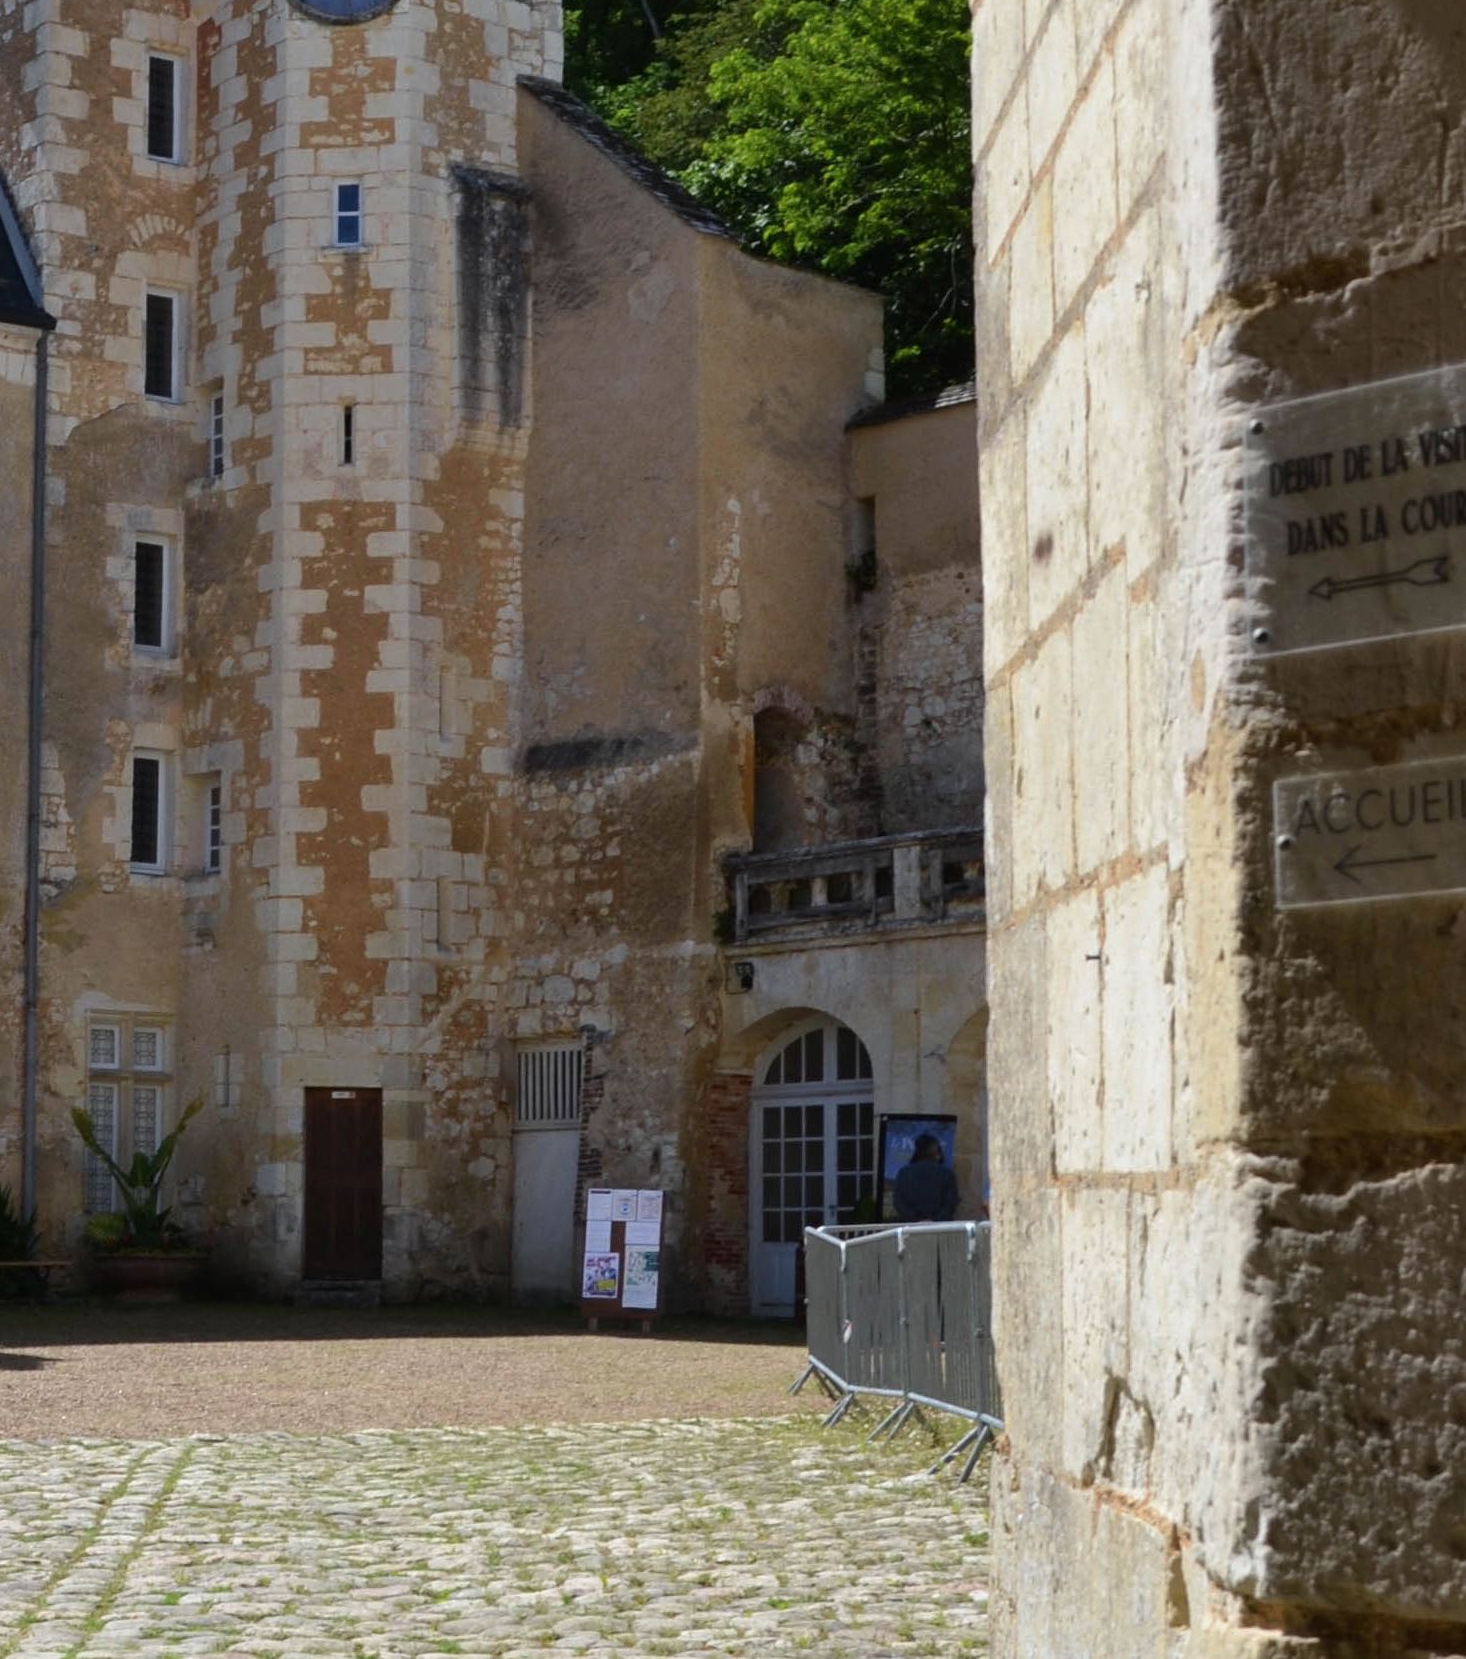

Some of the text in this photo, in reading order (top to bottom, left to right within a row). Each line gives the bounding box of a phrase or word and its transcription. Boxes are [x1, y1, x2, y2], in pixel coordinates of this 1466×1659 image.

[1269, 451, 1334, 497] DEBUT
[1343, 443, 1372, 483] DE
[1380, 437, 1409, 476] LA
[1286, 510, 1351, 556] DANS
[1360, 505, 1389, 543] LA
